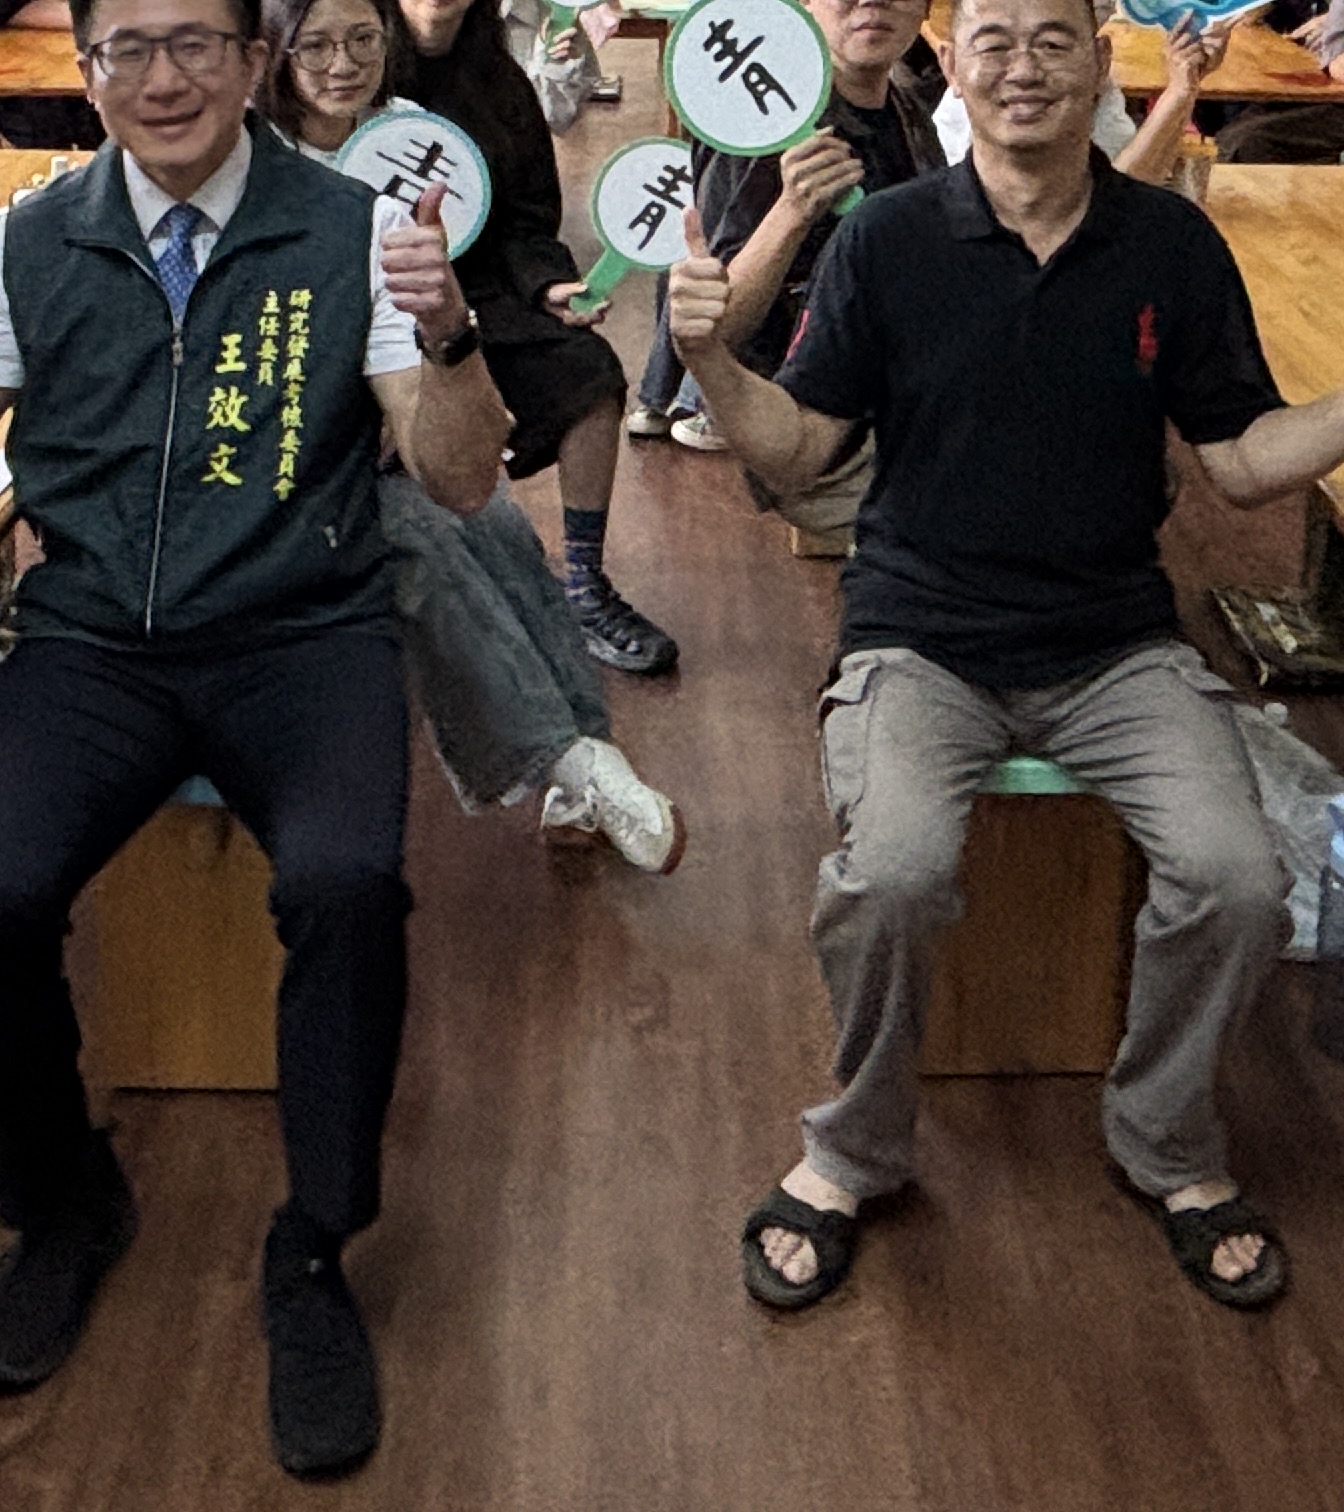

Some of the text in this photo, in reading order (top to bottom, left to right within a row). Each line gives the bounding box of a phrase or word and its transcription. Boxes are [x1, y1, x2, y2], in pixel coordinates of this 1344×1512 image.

[703, 18, 797, 116] 青
[255, 289, 281, 387] 主任委員
[272, 288, 313, 502] 研究發展考核委員會
[199, 332, 253, 487] 王效文
